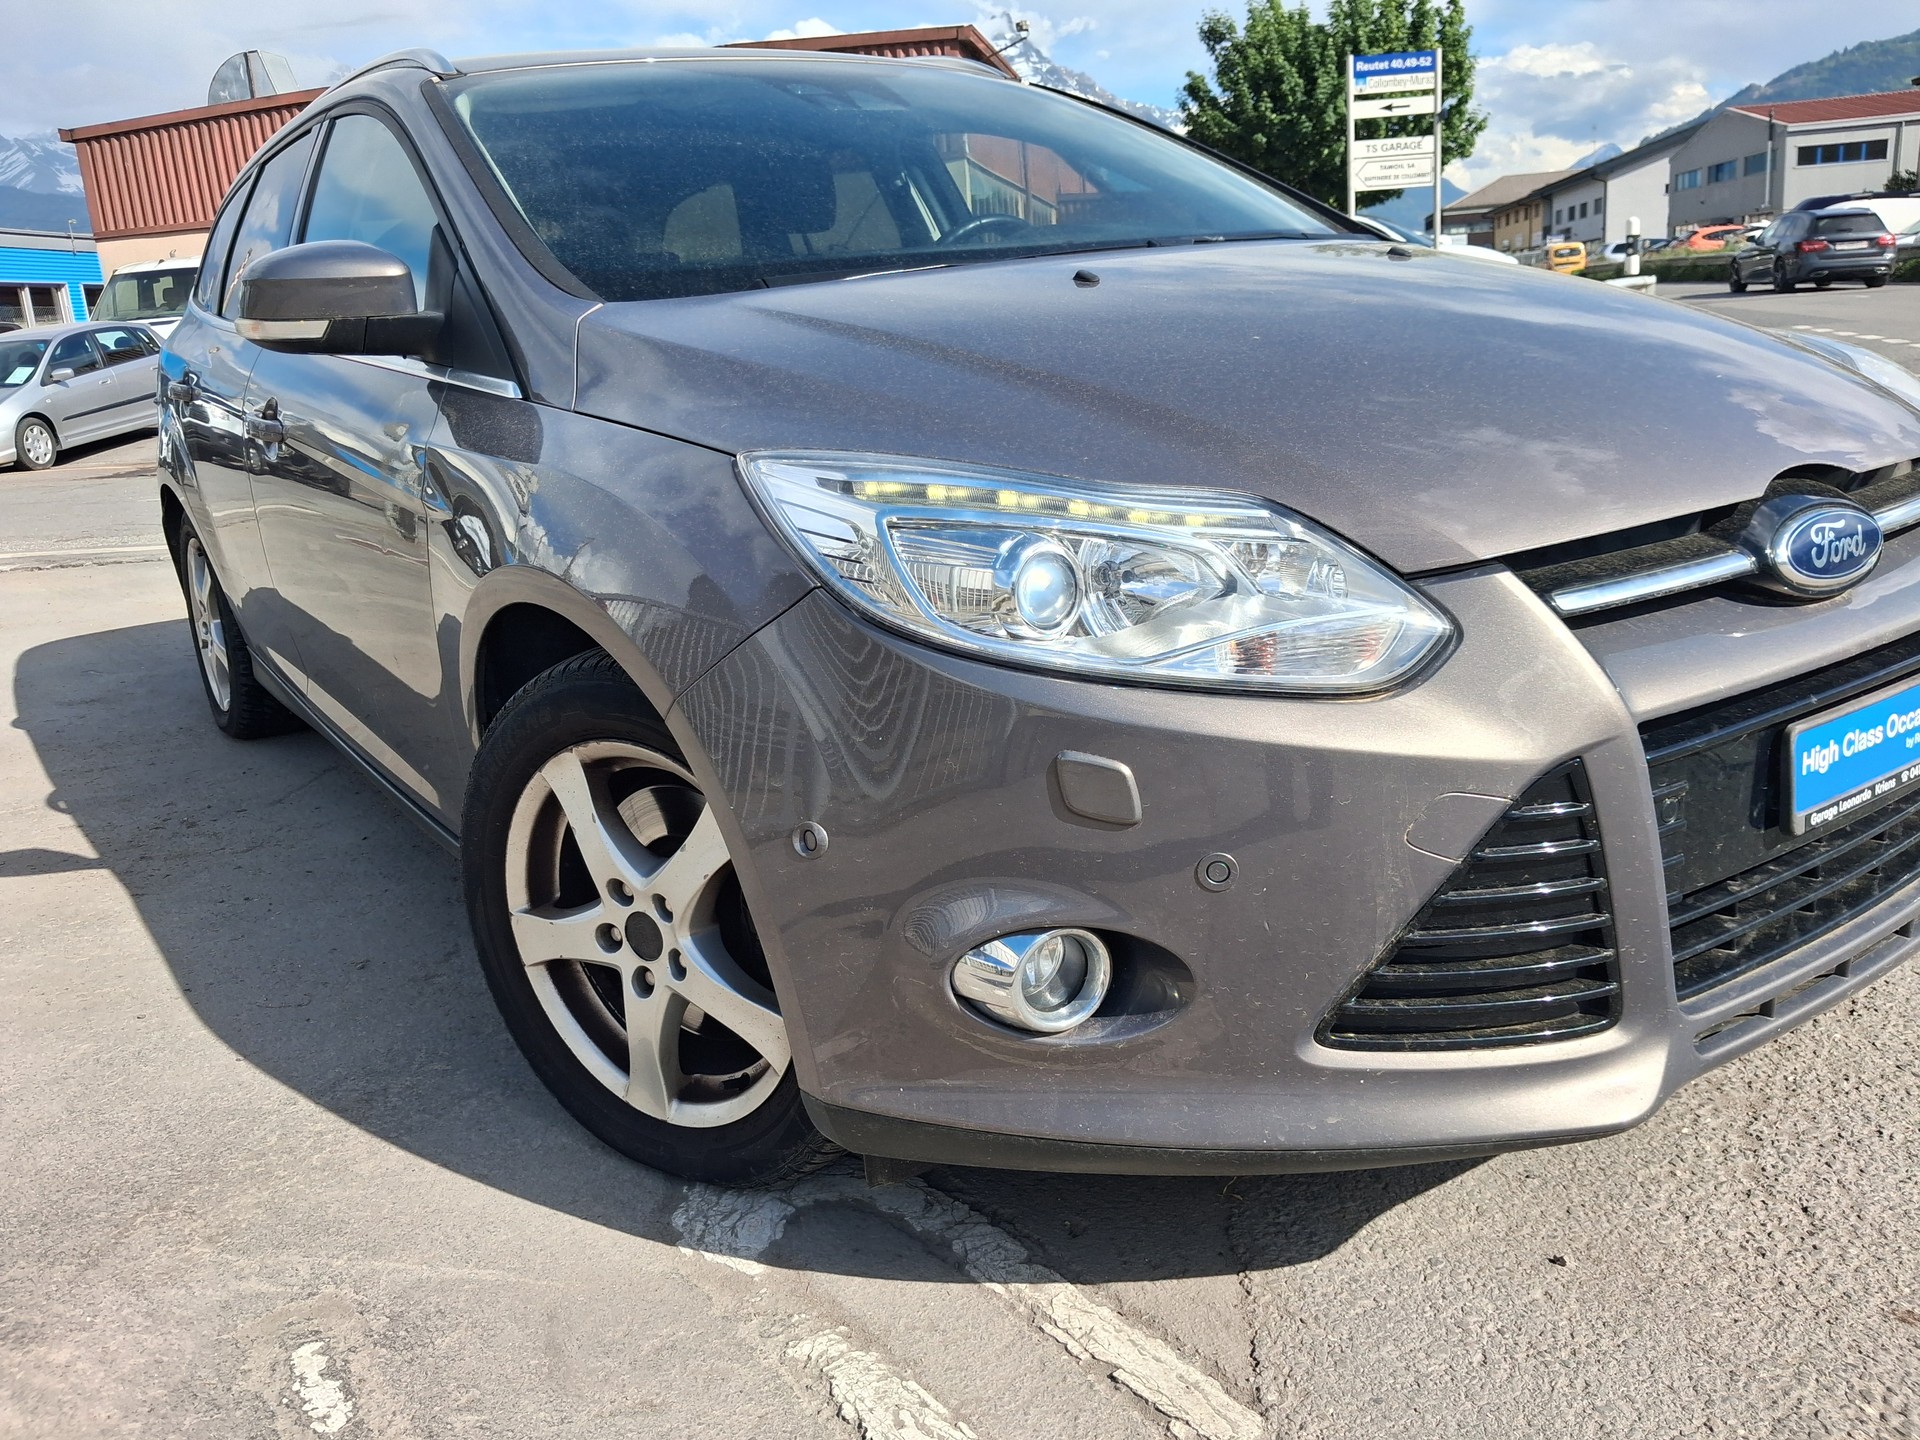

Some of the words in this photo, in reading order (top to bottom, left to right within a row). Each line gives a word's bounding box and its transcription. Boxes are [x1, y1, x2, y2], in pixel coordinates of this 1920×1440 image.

[1356, 60, 1389, 72] Reutet
[1365, 144, 1378, 153] TS
[1380, 141, 1423, 152] GARAGE
[1810, 519, 1866, 569] Ford
[1802, 739, 1839, 776] High
[1842, 724, 1884, 757] Class
[1810, 805, 1838, 825] Garage
[1839, 789, 1872, 813] Leonardo
[1874, 777, 1896, 796] Kriens
